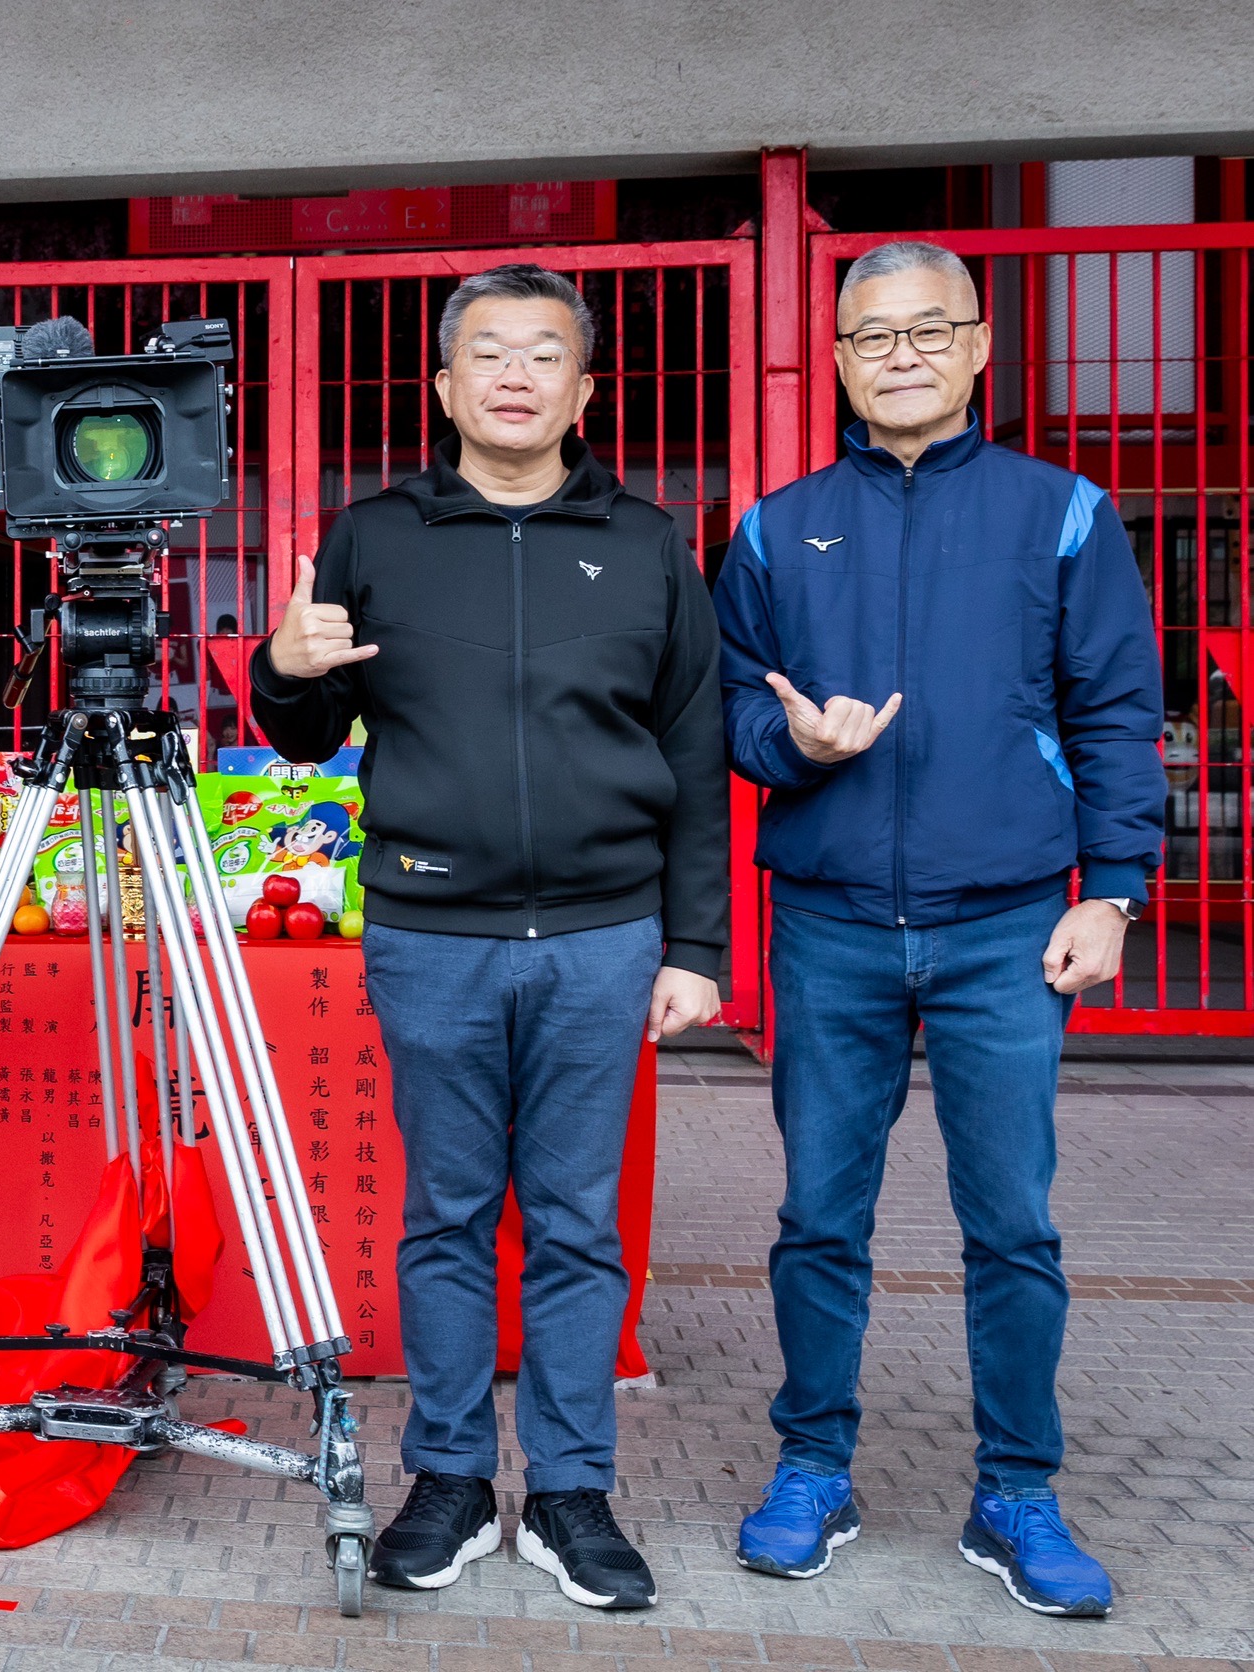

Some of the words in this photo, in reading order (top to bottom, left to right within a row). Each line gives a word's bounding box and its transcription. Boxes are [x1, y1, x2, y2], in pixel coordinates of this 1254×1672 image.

[84, 628, 120, 637] sachtler
[0, 963, 16, 1034] 行政監製
[307, 967, 330, 1018] 製作
[20, 1068, 35, 1124] 張永昌
[67, 1069, 83, 1129] 蔡其昌
[88, 1070, 103, 1128] 陳立白
[307, 1044, 331, 1256] 韶光電影有限
[354, 1044, 378, 1349] 威剛科技股份有限公司
